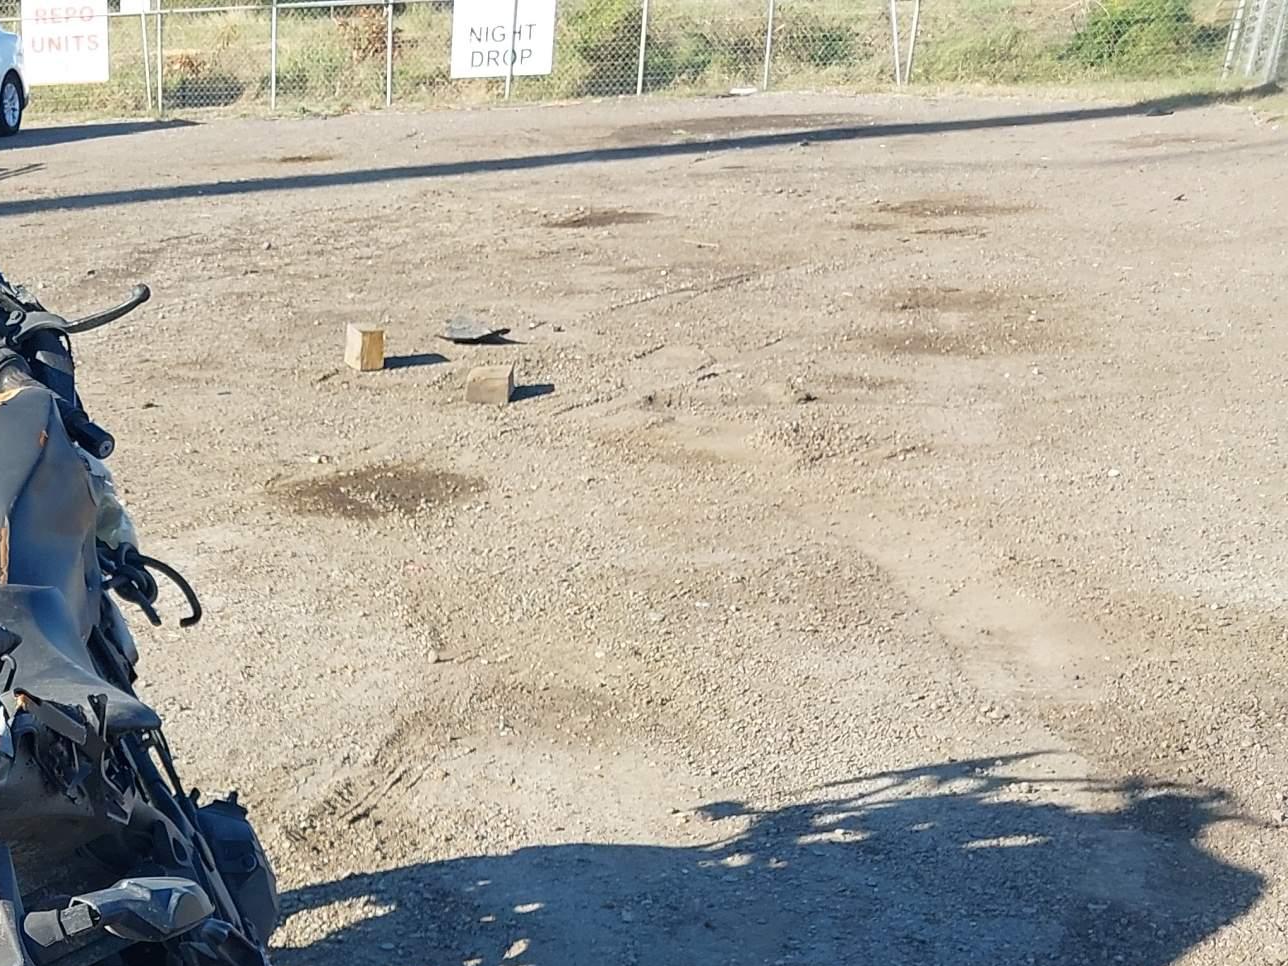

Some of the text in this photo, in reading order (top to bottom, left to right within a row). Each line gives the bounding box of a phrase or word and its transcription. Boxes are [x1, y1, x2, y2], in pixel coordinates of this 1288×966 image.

[35, 6, 94, 24] REPO
[469, 23, 537, 43] NIGHT
[31, 34, 100, 53] UNITS
[471, 48, 533, 68] DROP
